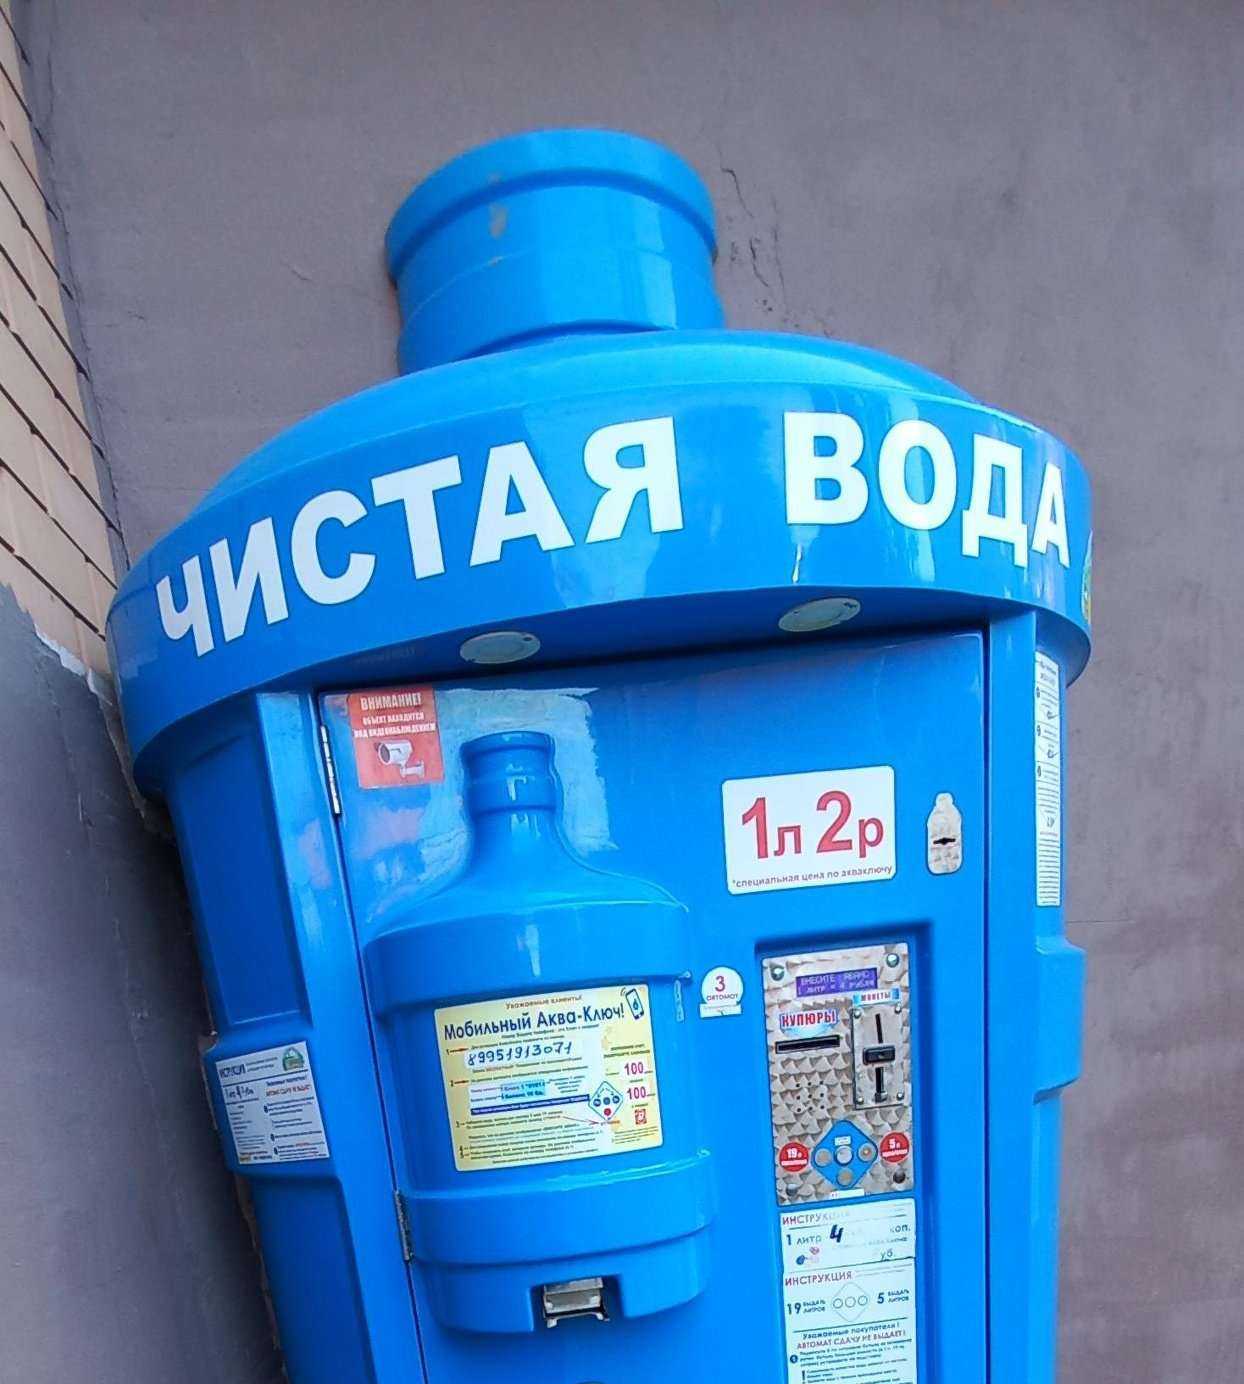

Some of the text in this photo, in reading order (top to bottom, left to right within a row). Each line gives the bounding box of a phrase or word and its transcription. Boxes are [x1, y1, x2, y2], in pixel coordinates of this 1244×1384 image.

[156, 411, 1071, 657] ЧИСТАЯ ВОДА
[360, 692, 421, 710] ВНИМАНИЕ!
[801, 871, 825, 883] цена
[828, 871, 839, 880] по
[841, 865, 892, 878] акваключу
[715, 975, 725, 992] 3
[861, 992, 891, 1002] МОНЕТЫ
[444, 1012, 532, 1041] Мобильный
[536, 1003, 625, 1028] Аква-Ключ!
[782, 1011, 836, 1027] КУПЮРЫ
[624, 1061, 644, 1076] 100
[627, 1086, 646, 1101] 100
[782, 1208, 849, 1226] ИНСТРУК
[786, 1233, 792, 1246] 1
[830, 1224, 844, 1243] 4
[785, 1270, 852, 1287] ИНСТРУКЦИЯ
[877, 1292, 885, 1305] 5
[787, 1302, 801, 1315] 19
